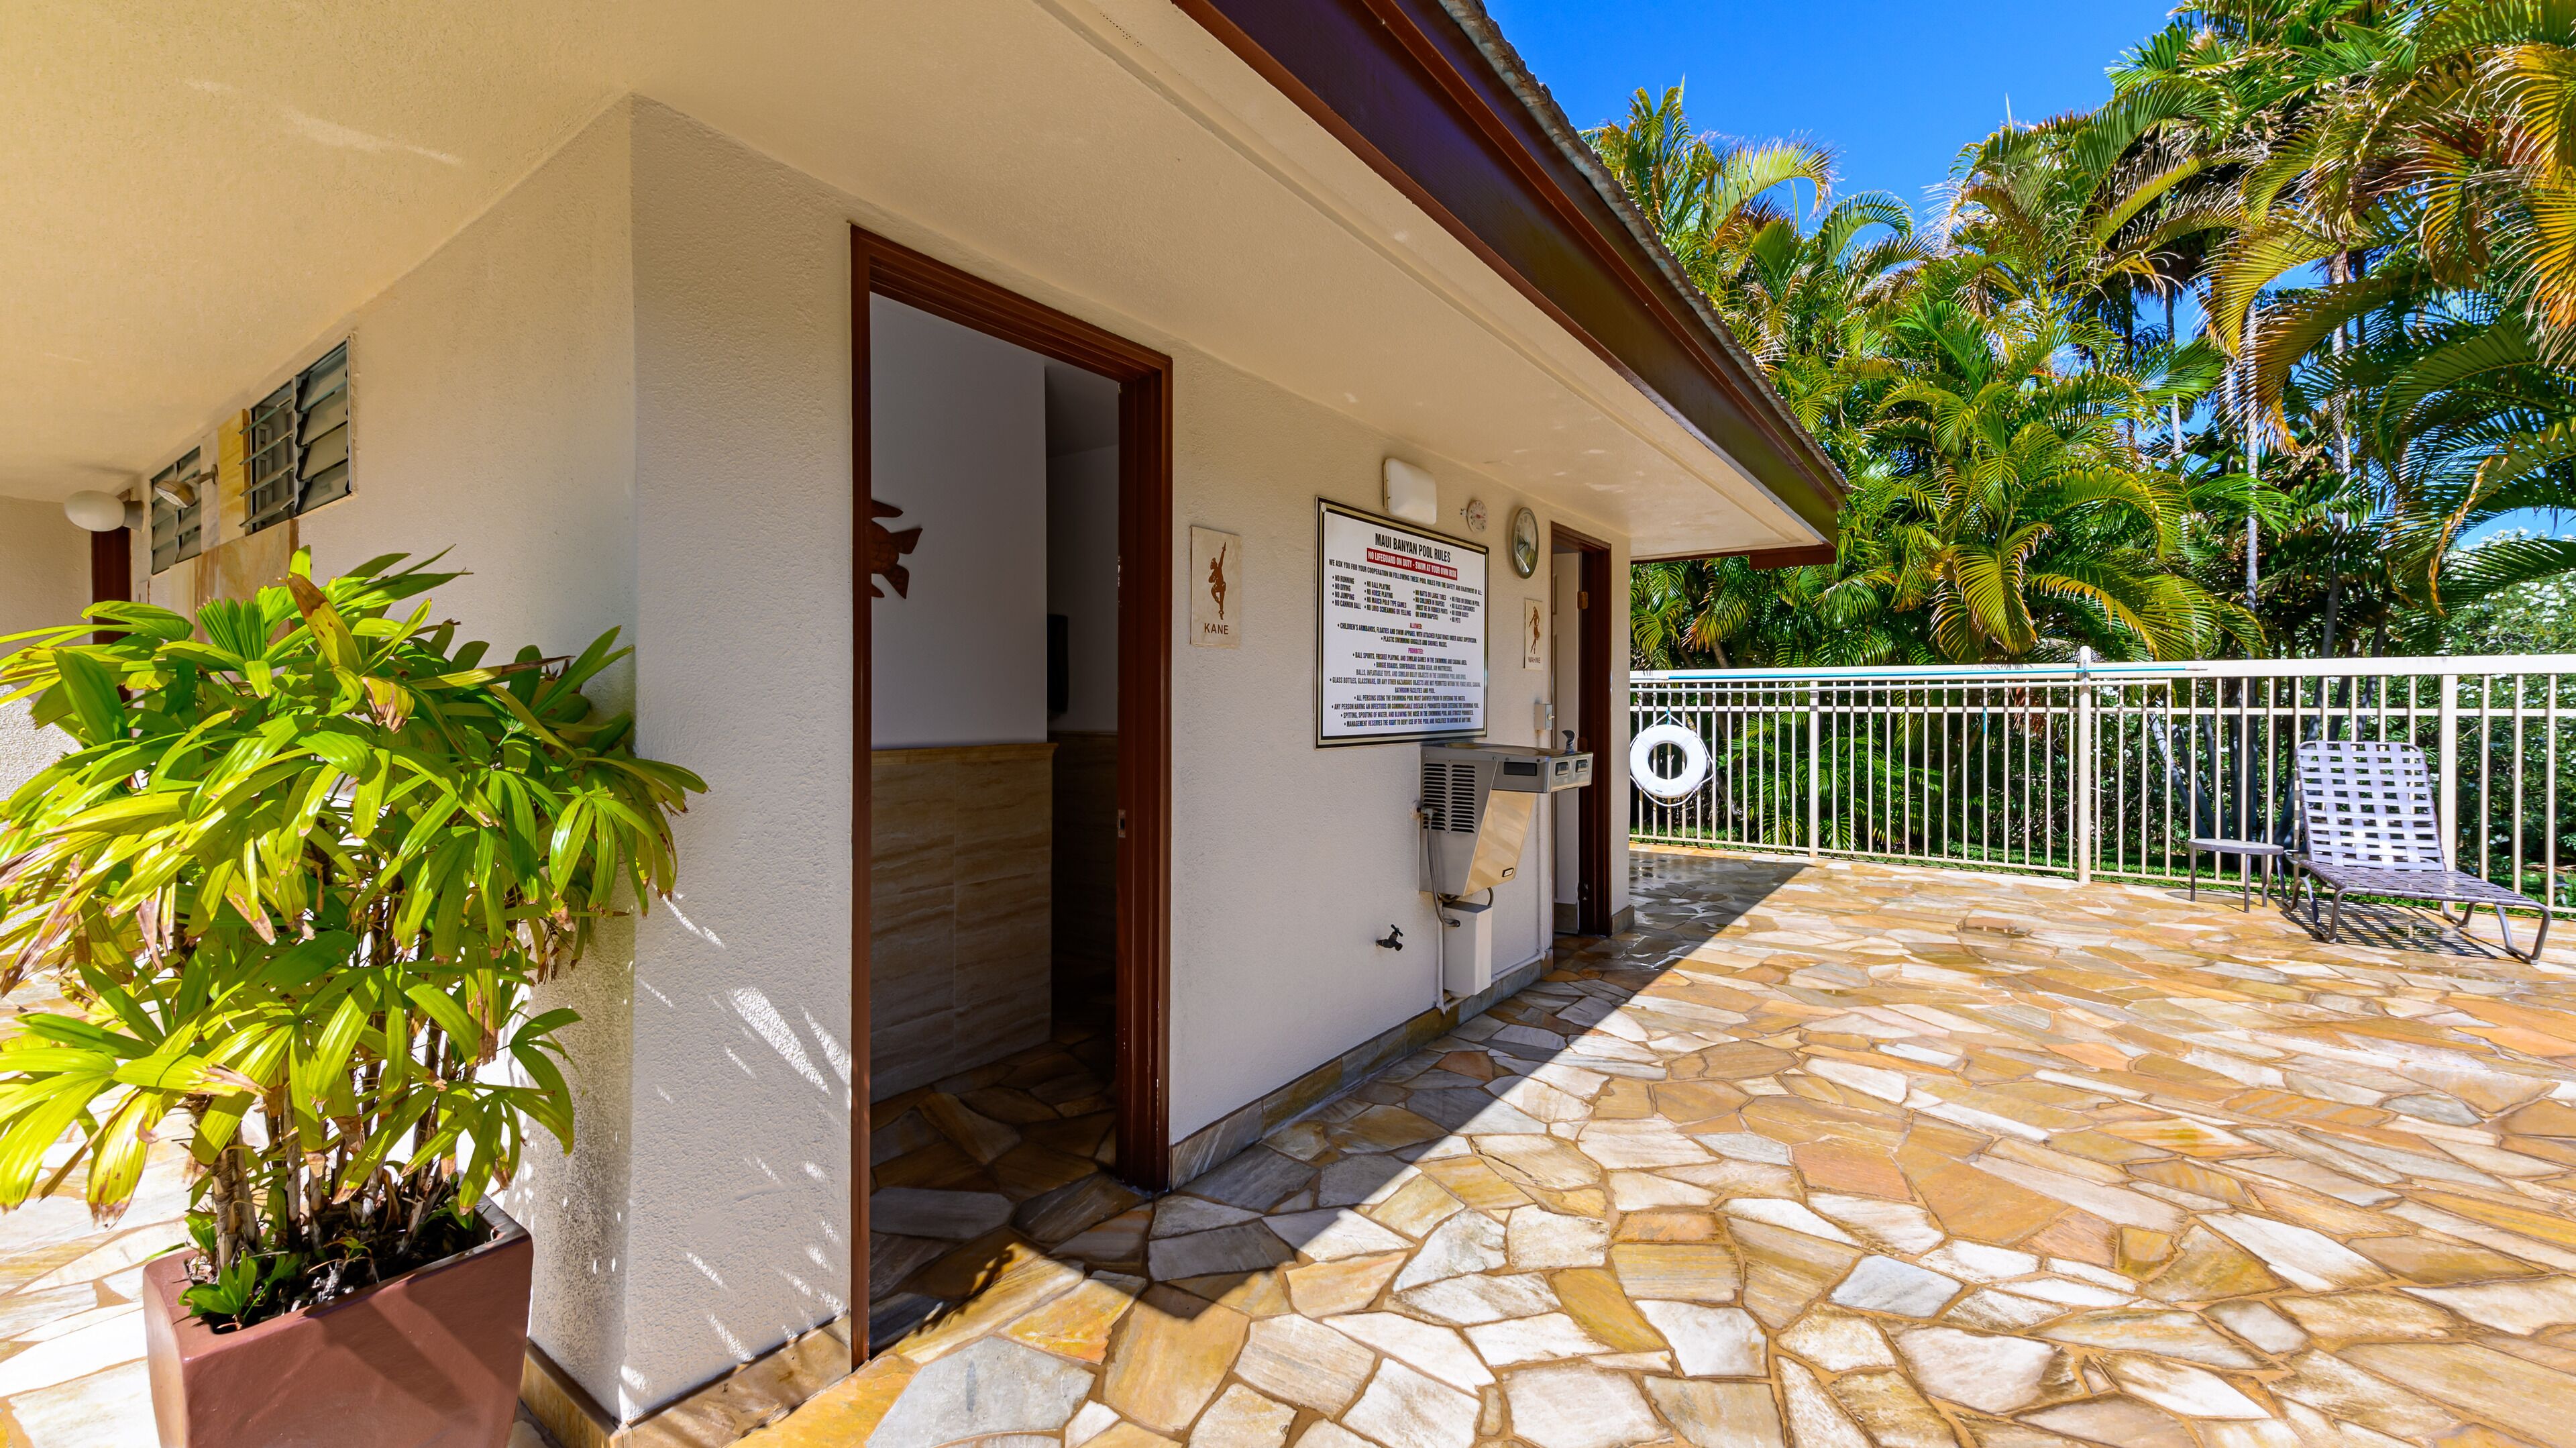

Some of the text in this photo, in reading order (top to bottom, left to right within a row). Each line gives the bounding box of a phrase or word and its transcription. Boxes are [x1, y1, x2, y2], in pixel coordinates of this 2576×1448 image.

[1375, 533, 1451, 563] MAUI BANYAN POOL RULES
[1368, 551, 1374, 560] NO
[1375, 552, 1395, 564] LIFEGUARD
[1397, 557, 1402, 566] ON
[1403, 559, 1411, 568] DUTY
[1415, 562, 1426, 571] SWIM
[1432, 565, 1440, 574] YOUR
[1368, 567, 1388, 577] COOPERATION
[1393, 572, 1409, 581] FOLLOWING
[1340, 576, 1354, 584] RUNNING
[1340, 584, 1350, 592] DIVING
[1341, 592, 1354, 601] JUMPING
[1380, 606, 1395, 614] SCREAMING
[1204, 623, 1228, 635] KANE
[1340, 623, 1358, 631] CHILDREN'S
